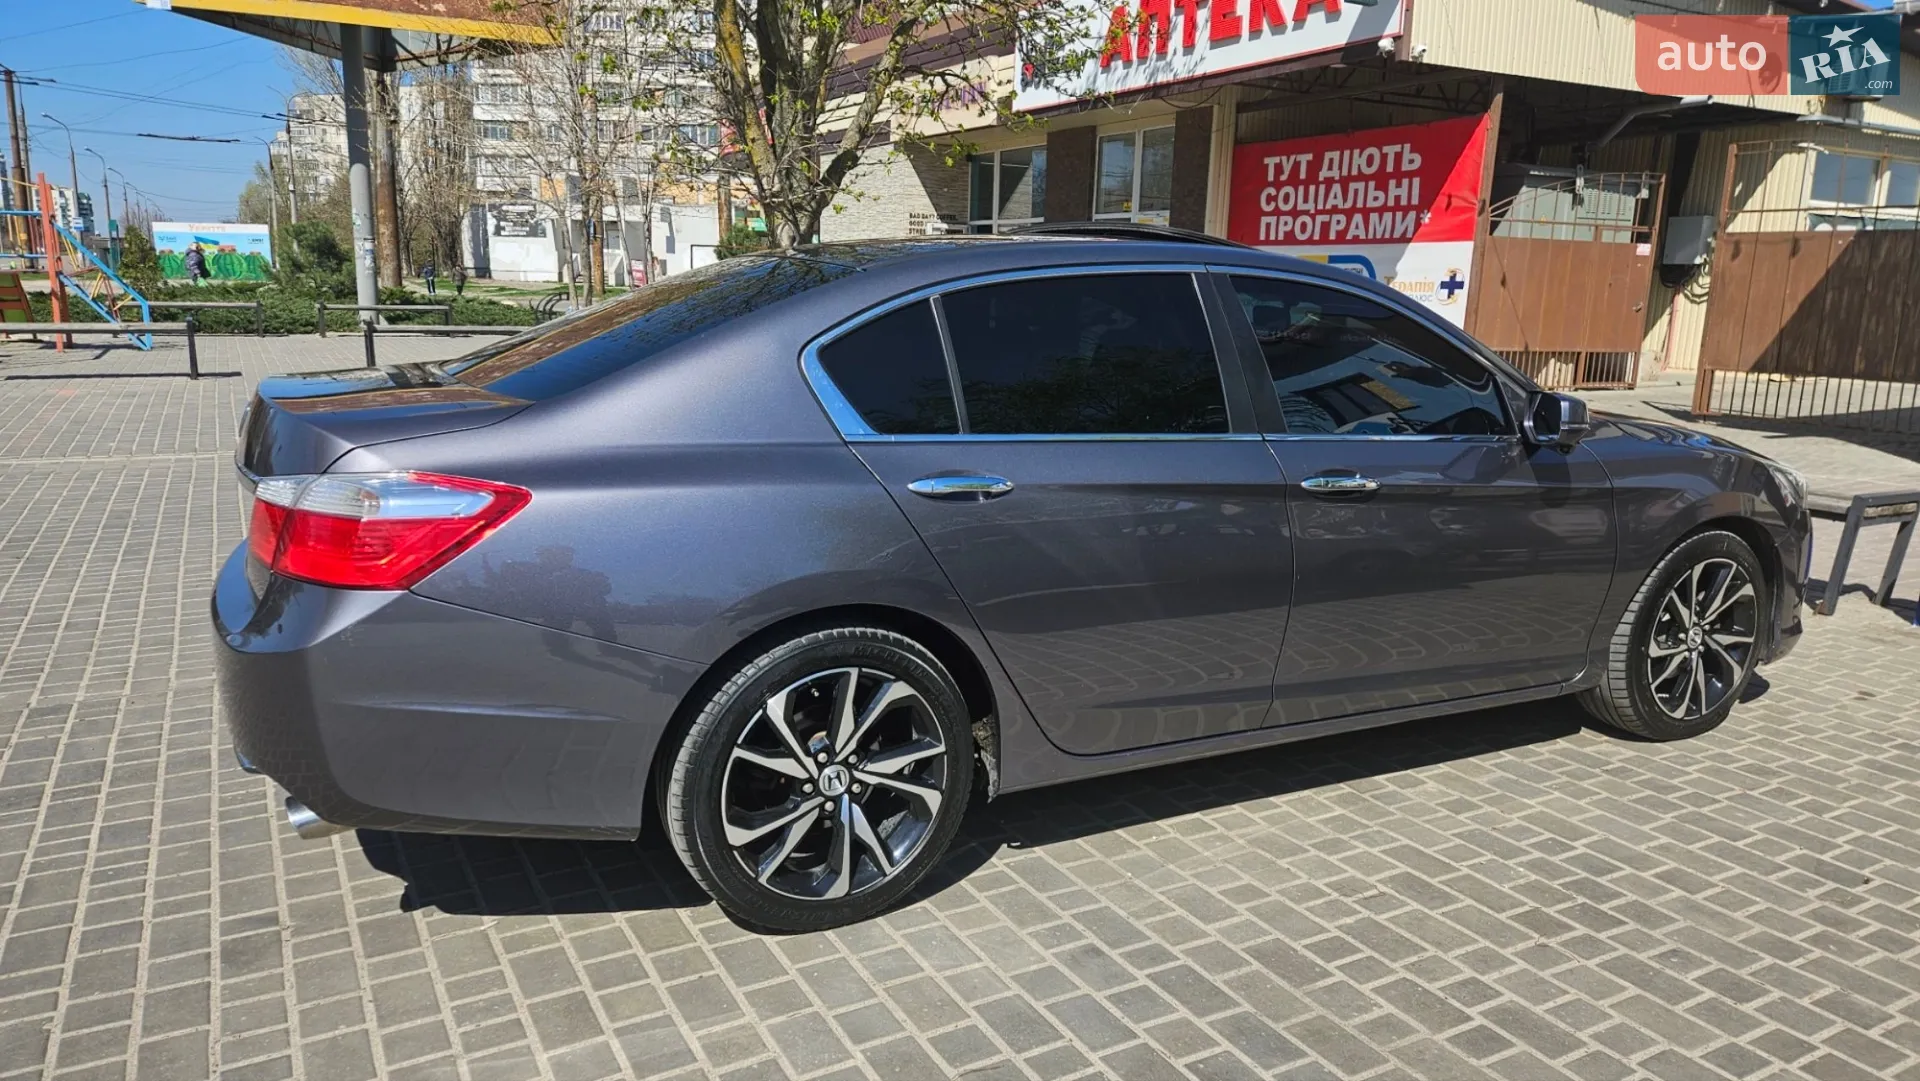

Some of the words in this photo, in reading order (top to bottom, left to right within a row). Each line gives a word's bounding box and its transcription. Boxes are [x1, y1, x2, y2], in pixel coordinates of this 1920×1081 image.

[1263, 153, 1313, 182] ТУТ
[1318, 143, 1422, 181] ДІЮТЬ
[1259, 177, 1421, 214] СОЦІАЛЬНІ
